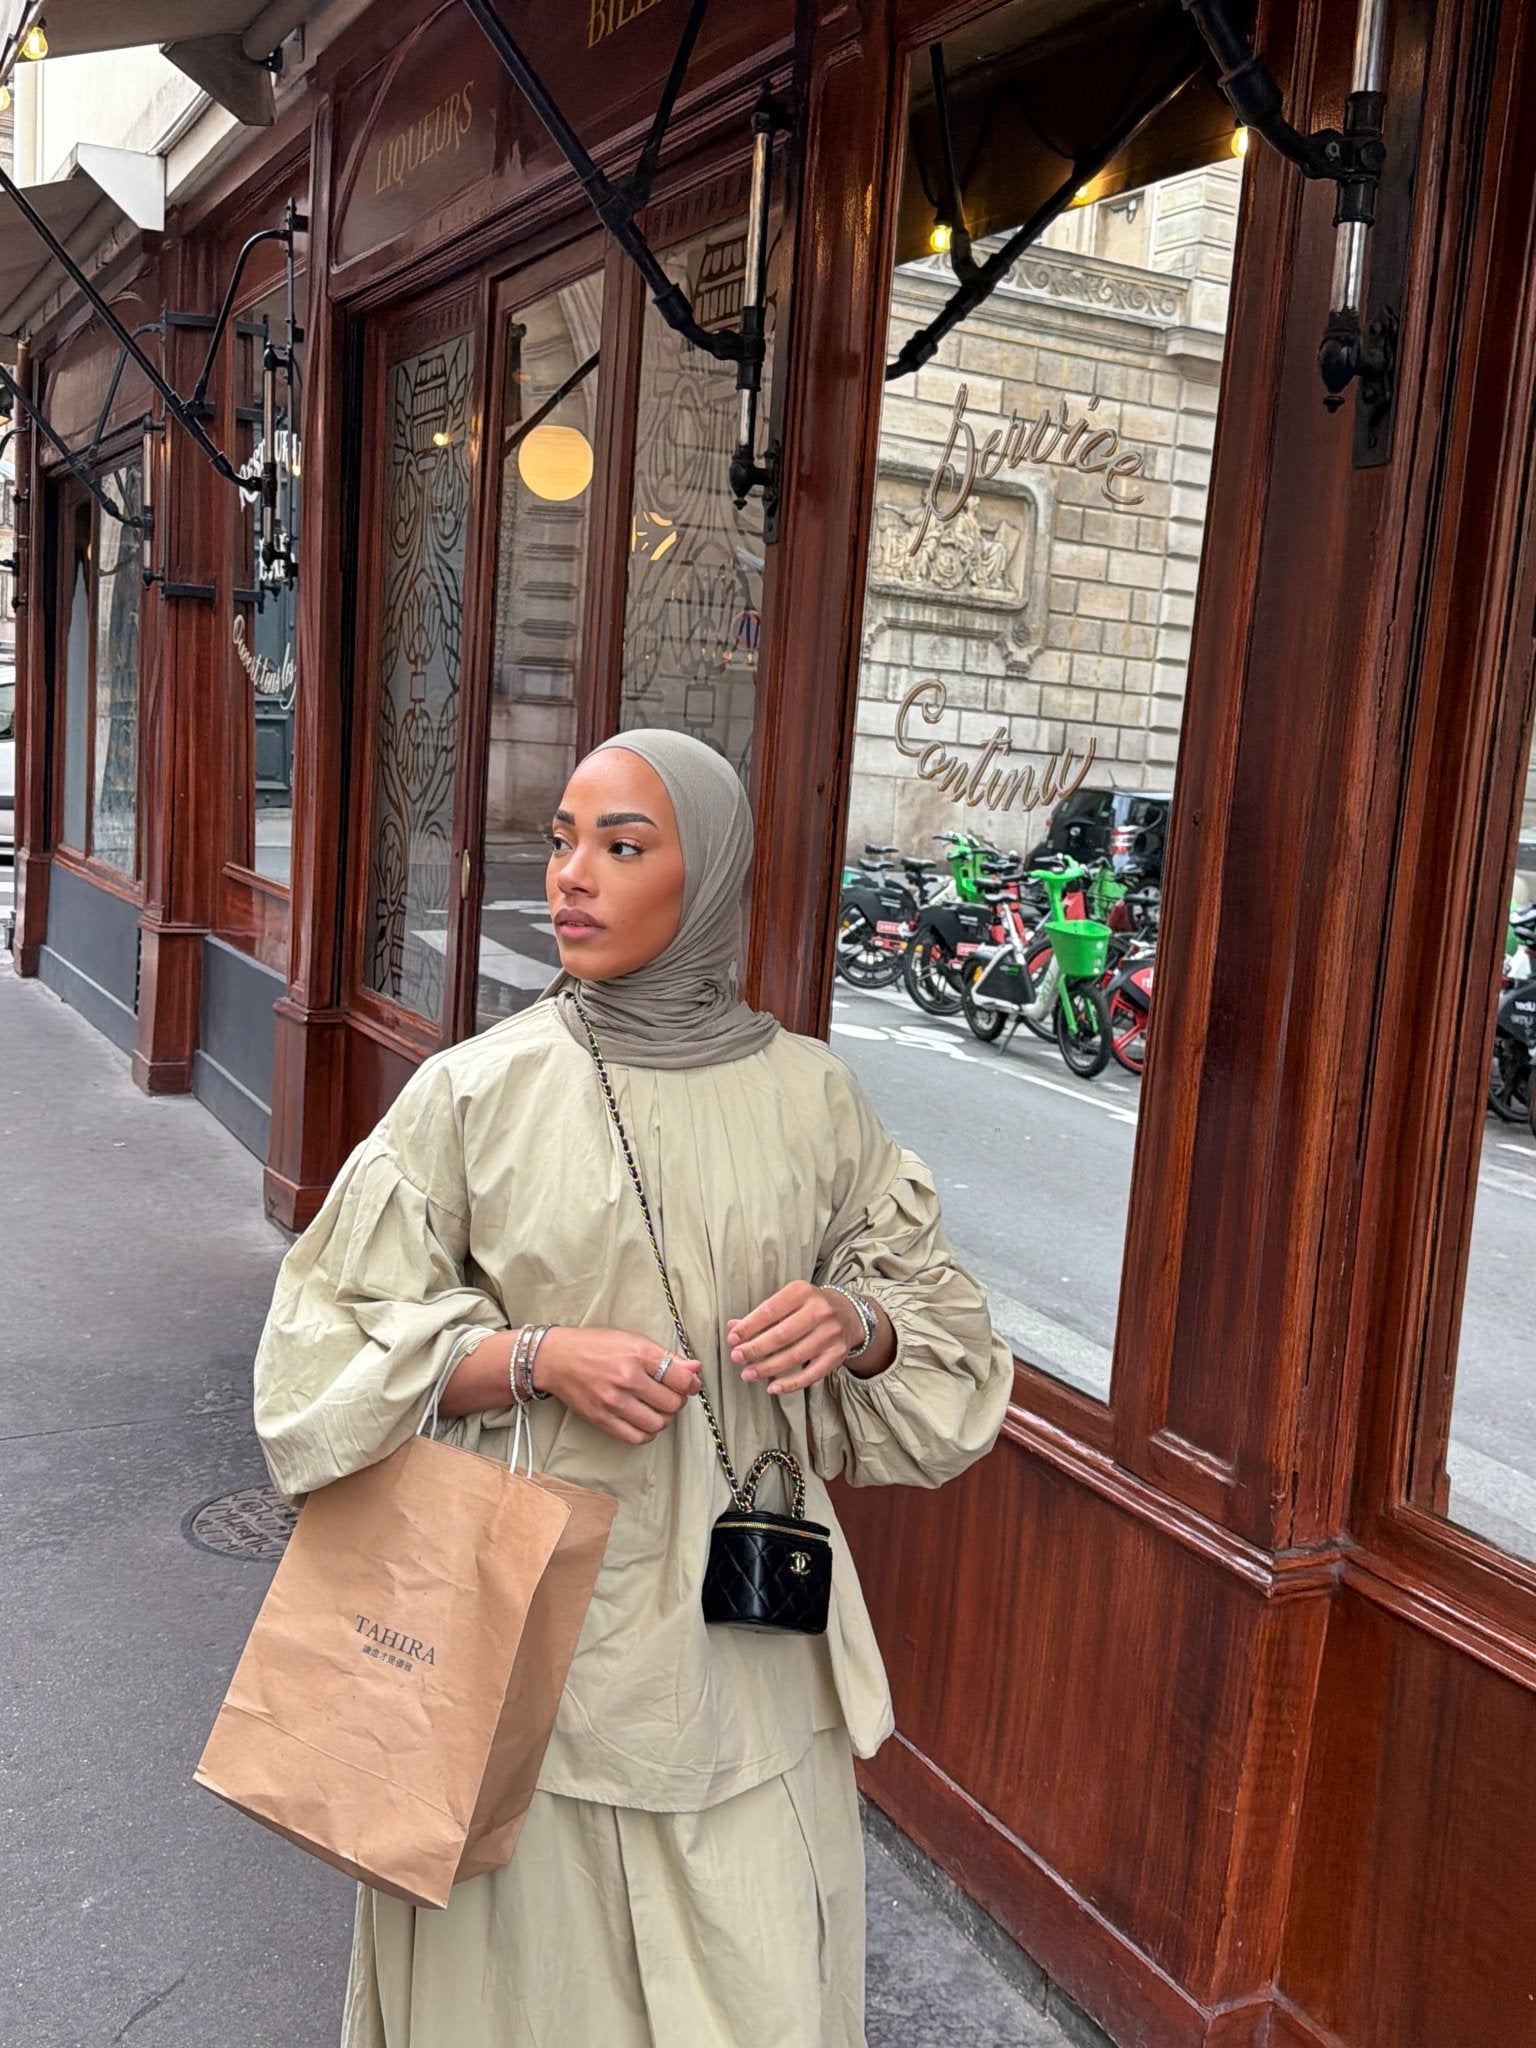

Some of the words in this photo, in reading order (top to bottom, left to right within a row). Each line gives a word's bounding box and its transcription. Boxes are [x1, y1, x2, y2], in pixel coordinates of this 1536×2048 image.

[375, 80, 475, 195] LIQUEURS
[909, 382, 1146, 556] Service
[895, 678, 1097, 813] Continu
[355, 1614, 436, 1666] TAHIRA
